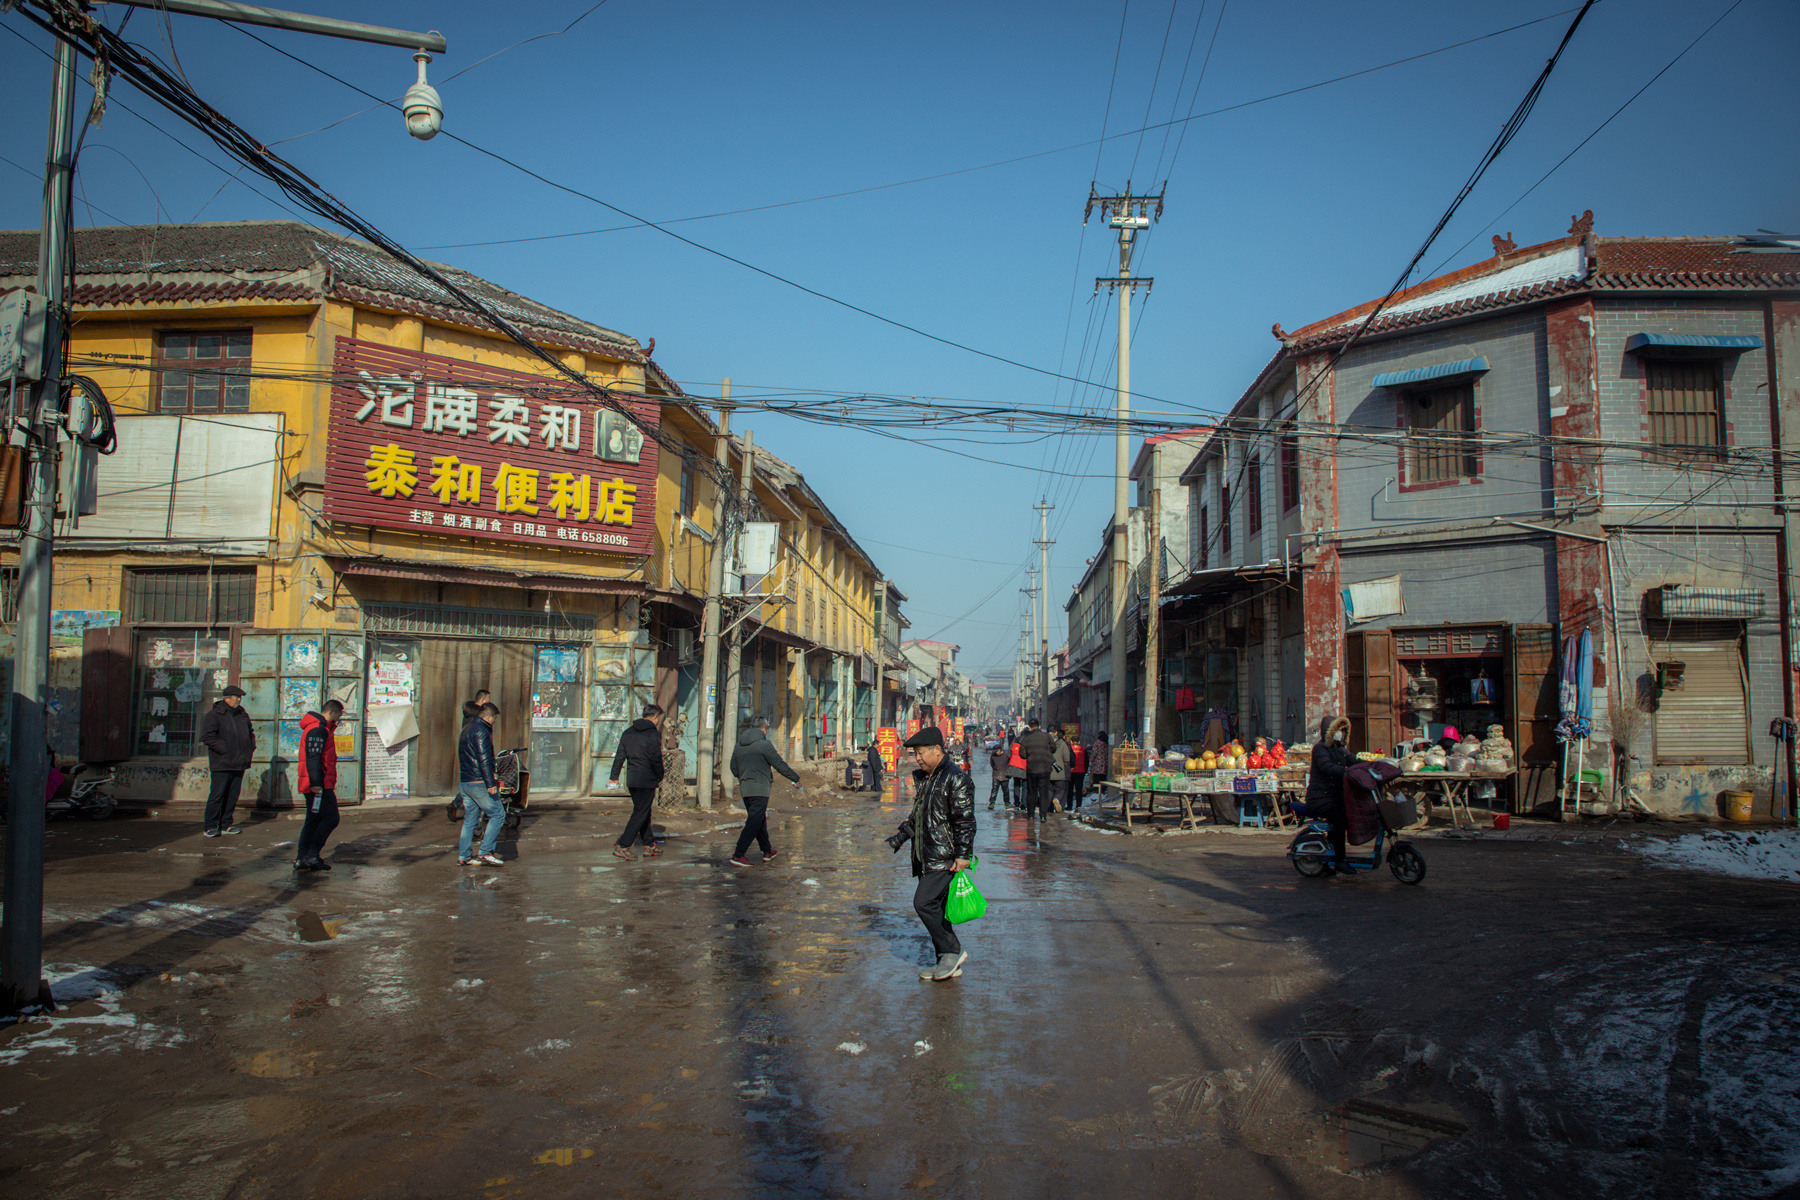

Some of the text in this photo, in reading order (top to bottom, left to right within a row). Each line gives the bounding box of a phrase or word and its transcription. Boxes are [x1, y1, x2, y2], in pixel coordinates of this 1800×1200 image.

[363, 443, 637, 527] 泰和便利店
[408, 509, 629, 547] 主营 烟酒副食 日用品 电话 6588096
[878, 729, 895, 771] 土产日用品
